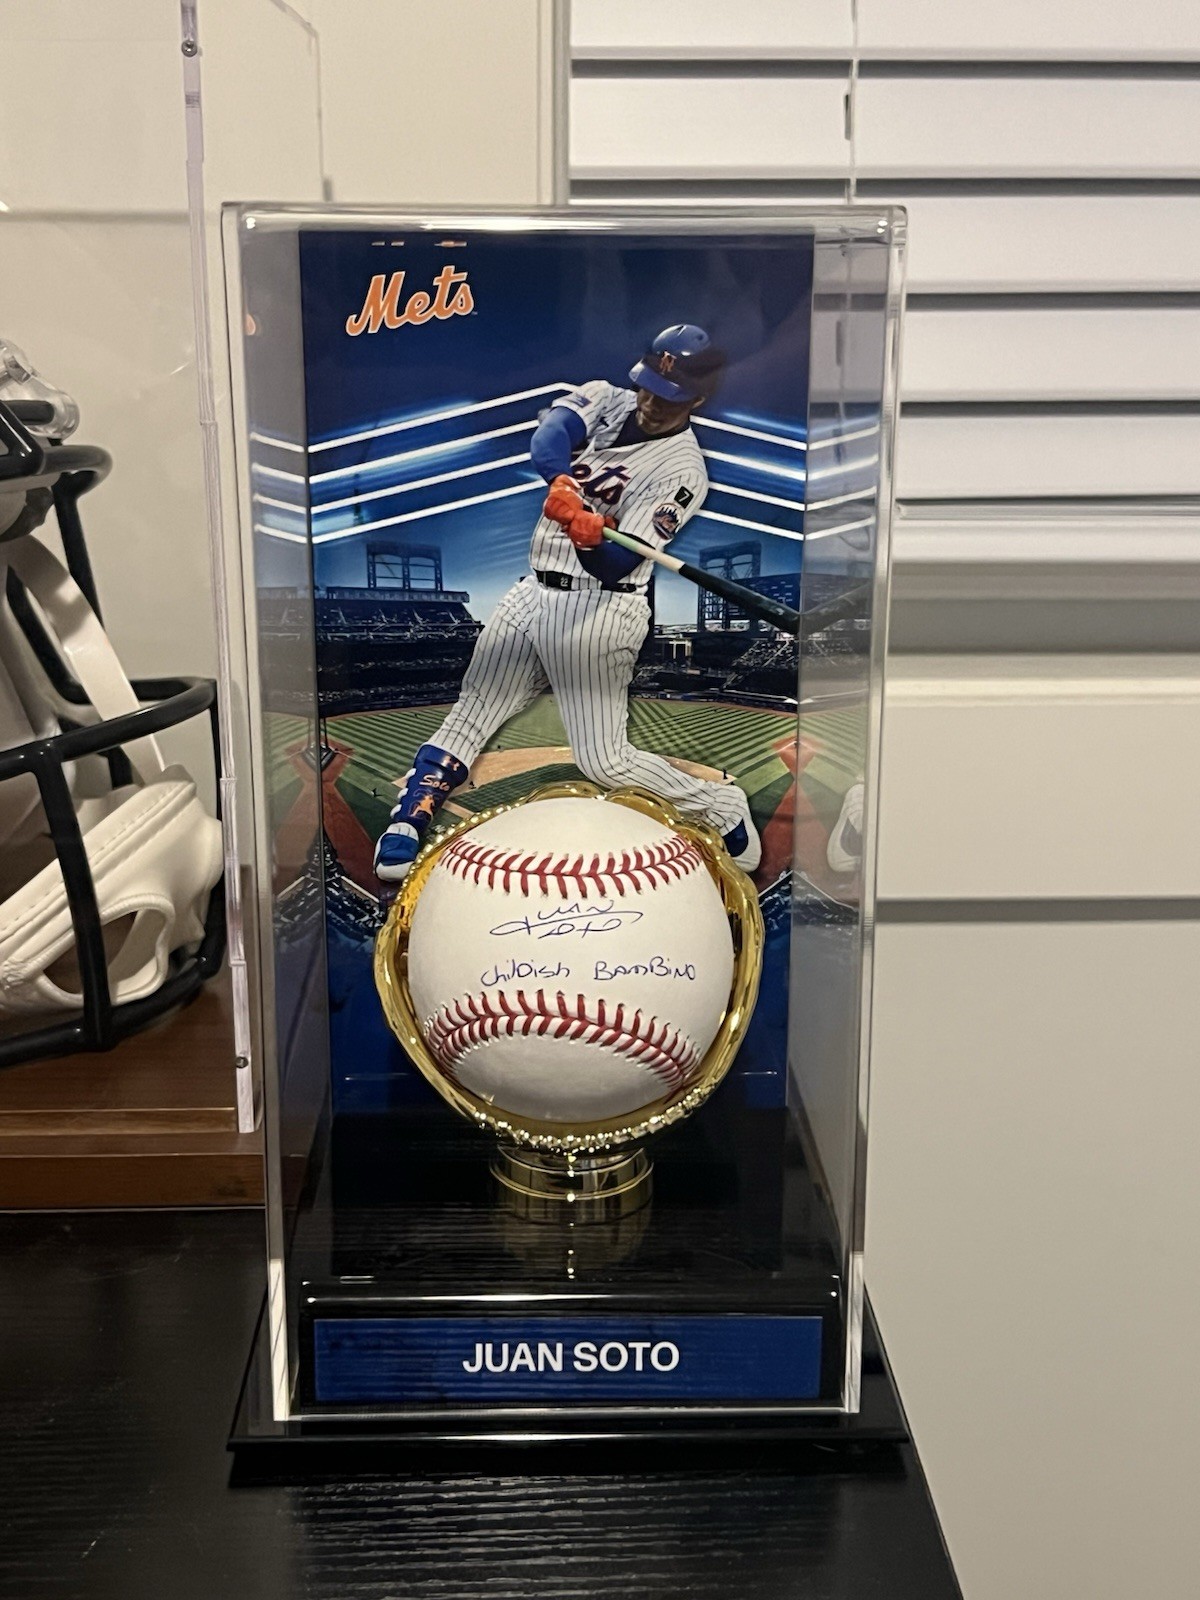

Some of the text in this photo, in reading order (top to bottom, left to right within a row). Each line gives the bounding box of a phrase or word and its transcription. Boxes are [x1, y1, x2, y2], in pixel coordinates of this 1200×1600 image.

[345, 265, 474, 336] Mets
[571, 464, 631, 505] ets
[462, 1341, 680, 1373] JUAN SOTO
